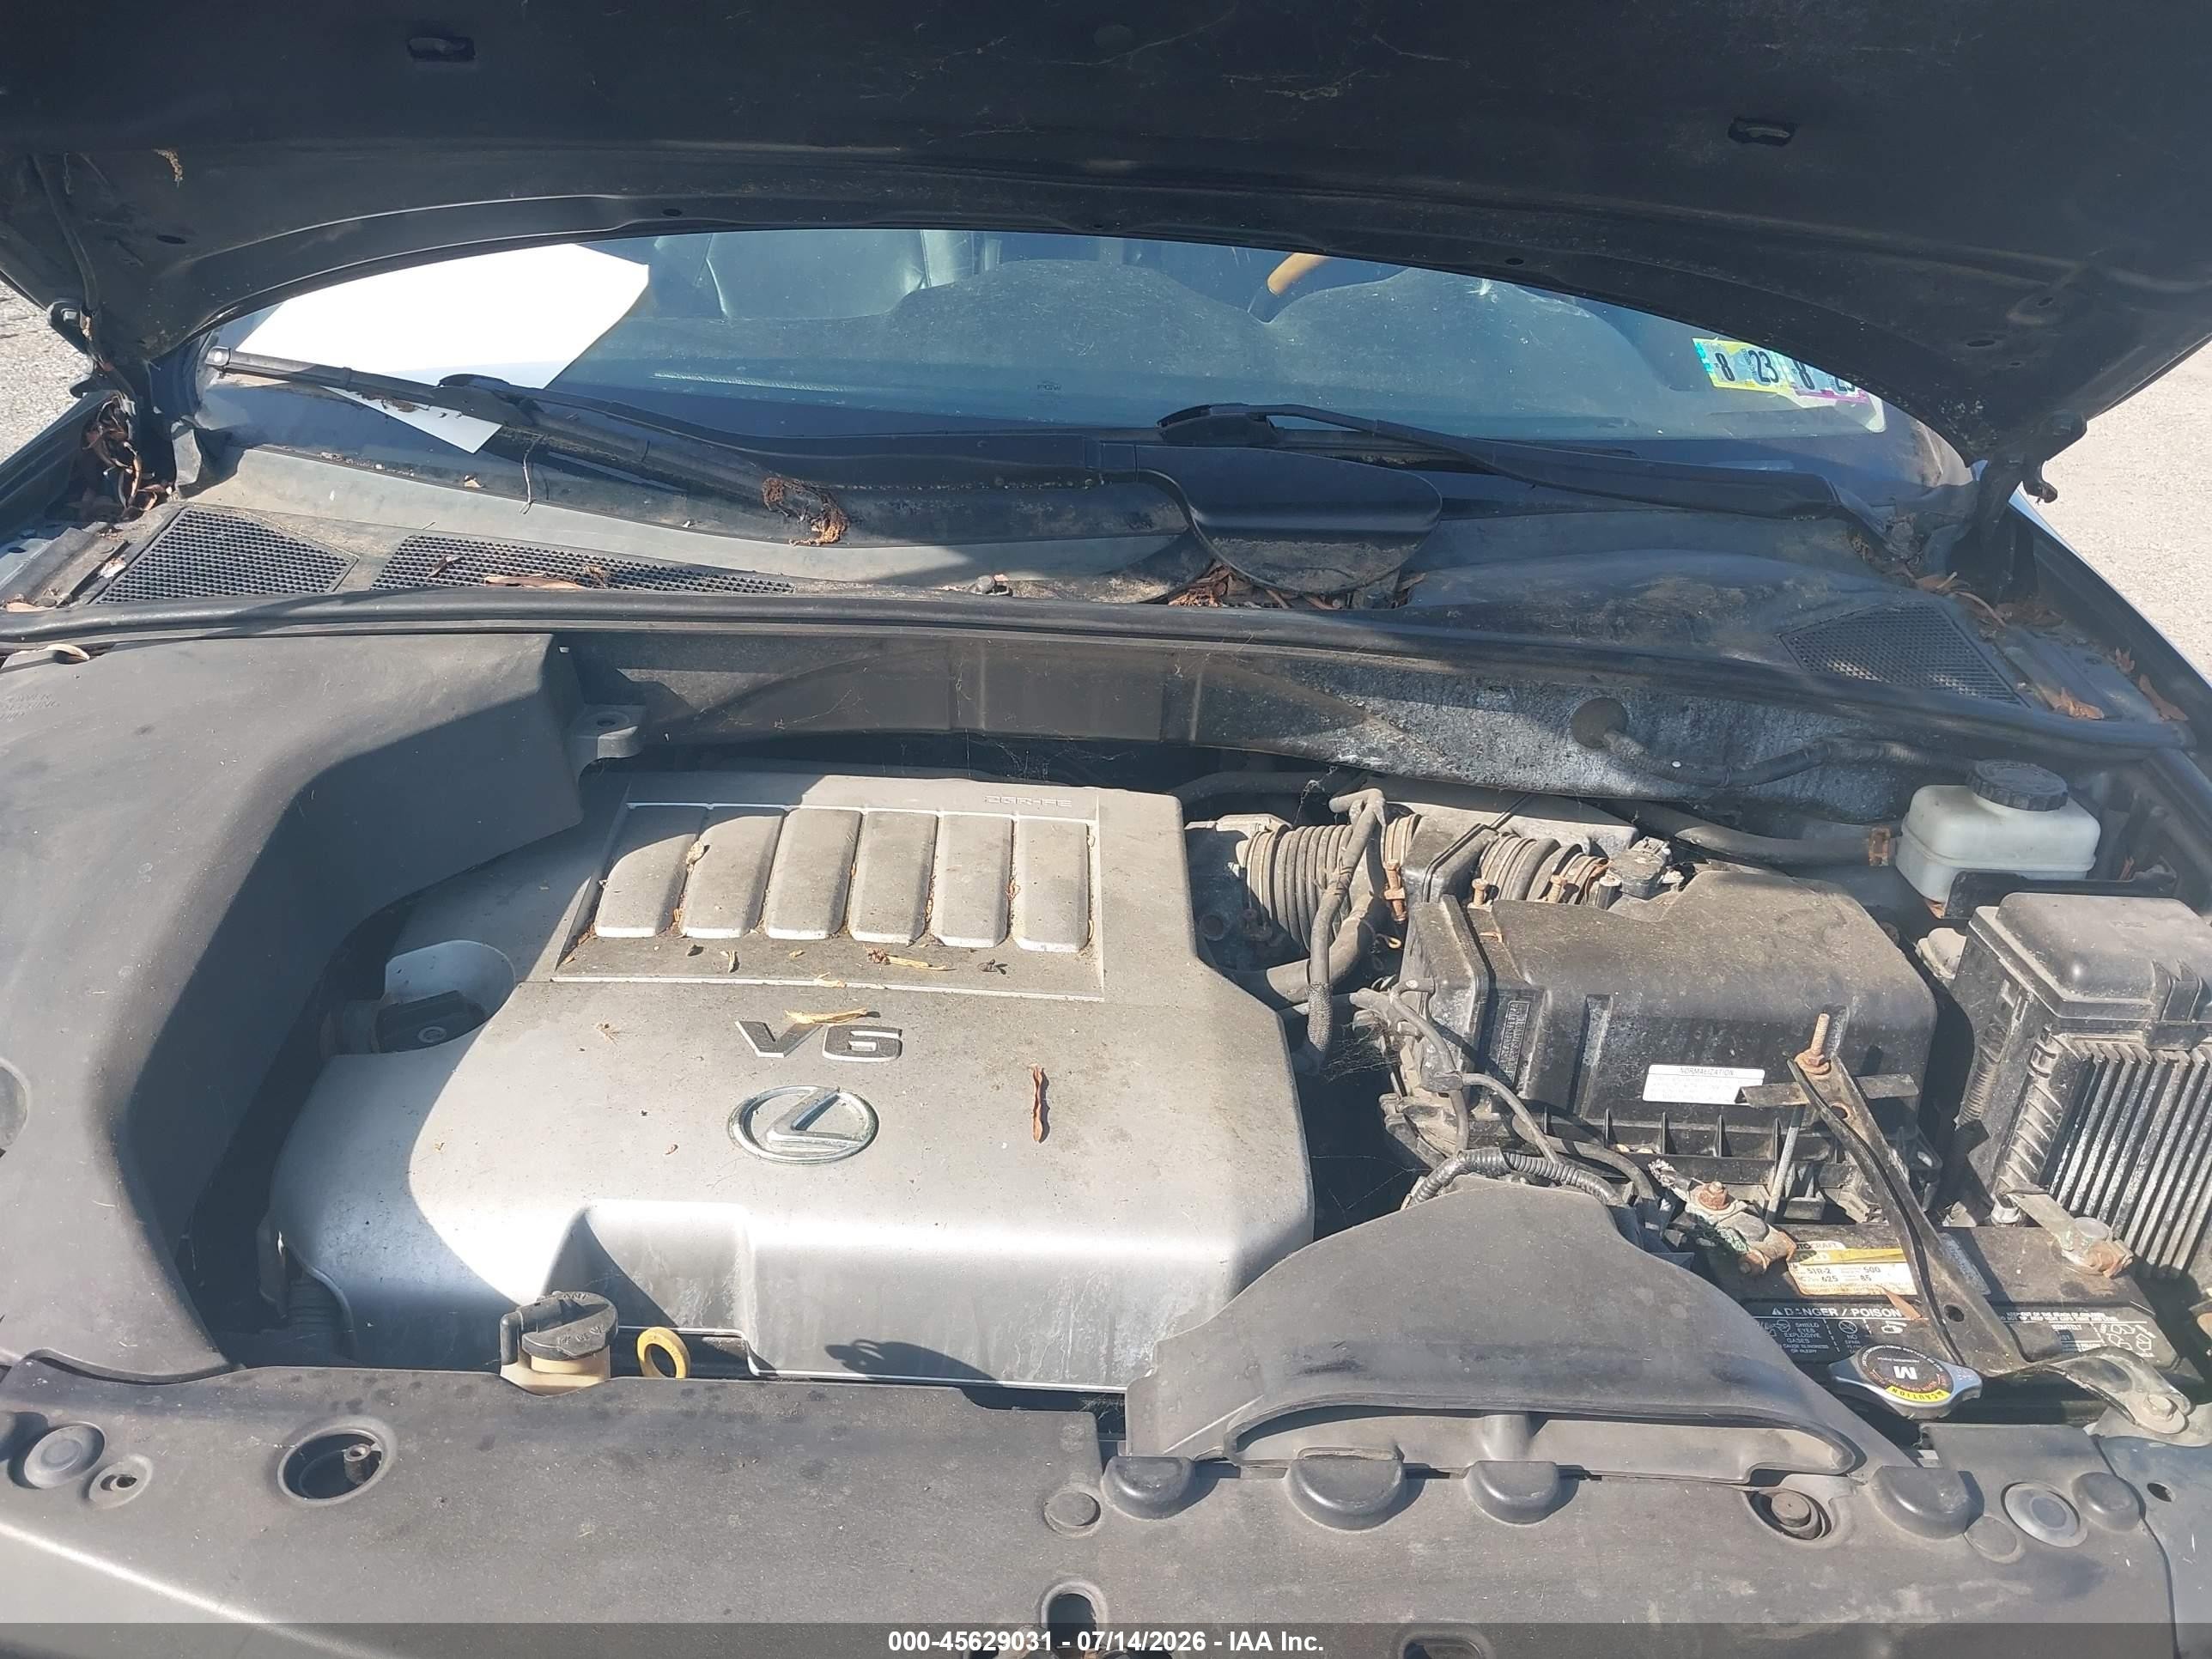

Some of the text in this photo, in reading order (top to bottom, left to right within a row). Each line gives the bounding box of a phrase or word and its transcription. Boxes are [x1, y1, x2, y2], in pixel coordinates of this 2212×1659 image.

[1715, 353, 1735, 381] 8
[1748, 349, 1779, 384] 23
[735, 1020, 902, 1062] V6
[1680, 1066, 1735, 1076] NORMALIZATION
[1850, 1309, 1903, 1317] POISON
[1893, 1365, 1918, 1380] M
[1891, 1388, 1938, 1401] CAUTION
